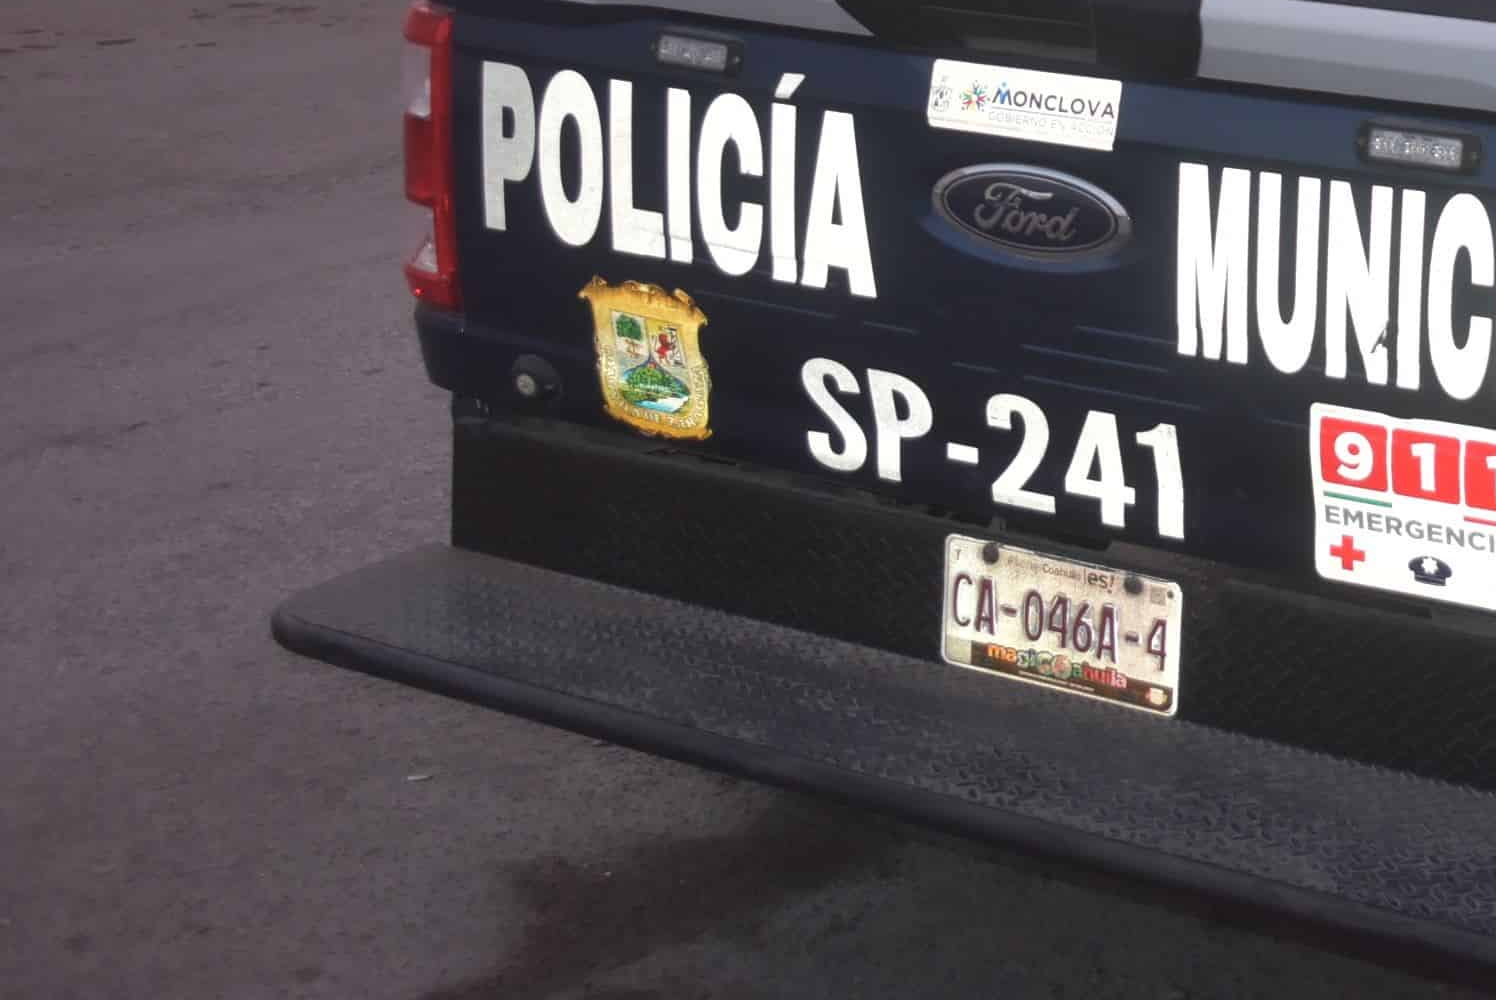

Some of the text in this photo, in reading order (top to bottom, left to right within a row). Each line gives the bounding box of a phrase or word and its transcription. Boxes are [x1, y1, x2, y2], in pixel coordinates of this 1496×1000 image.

[992, 83, 1115, 119] MONCLOVA
[483, 61, 877, 298] POLICÍA
[974, 182, 1080, 240] Ford
[802, 358, 1184, 539] SP-241
[952, 573, 1167, 672] CA-046A-4
